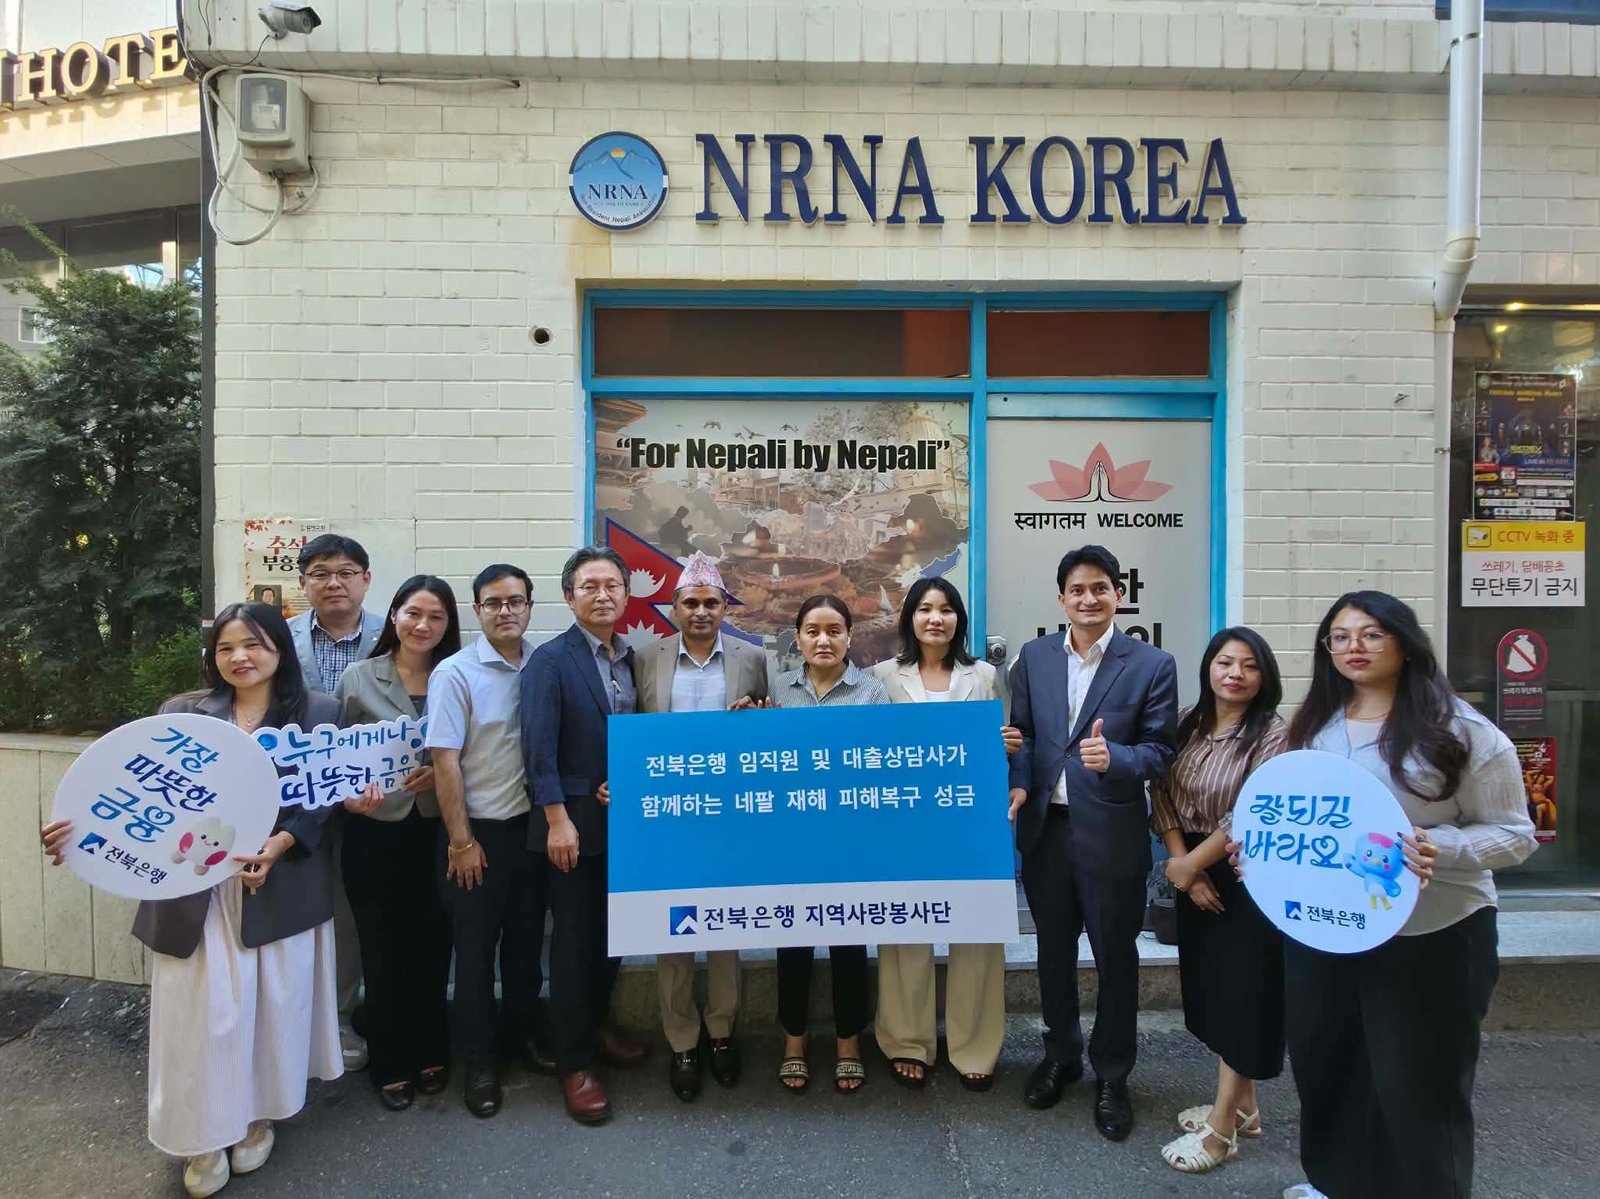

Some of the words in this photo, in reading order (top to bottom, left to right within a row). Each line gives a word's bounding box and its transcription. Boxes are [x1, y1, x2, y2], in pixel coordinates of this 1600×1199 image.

[588, 184, 648, 199] NRNA
[695, 133, 944, 226] NRNA
[968, 136, 1247, 227] KOREA
[686, 438, 786, 472] Nepali
[794, 439, 831, 472] by
[1014, 512, 1087, 530] स्वागतम
[1096, 513, 1184, 528] WELCOME
[1497, 530, 1532, 543] CCTV
[1536, 529, 1558, 544] 녹화
[1562, 529, 1575, 544] 중
[262, 555, 300, 572] 부흥
[1470, 577, 1538, 597] 무단투기
[1544, 577, 1578, 597] 금지
[150, 726, 220, 774] 가장
[645, 751, 727, 778] 전북은행
[738, 749, 799, 774] 임직원
[811, 747, 831, 771] 및
[842, 744, 967, 770] 대출상담사가
[124, 753, 218, 812] 따뜻한
[90, 786, 176, 843] 금융
[640, 794, 723, 819] 함께하는
[735, 792, 774, 814] 네팔
[786, 790, 827, 812] 재해
[839, 786, 922, 811] 피해복구
[934, 784, 975, 808] 성금
[104, 845, 168, 885] 전북은행
[703, 904, 795, 931] 전북은행
[805, 900, 952, 927] 지역사랑봉사단
[1306, 904, 1366, 930] 전북은행
